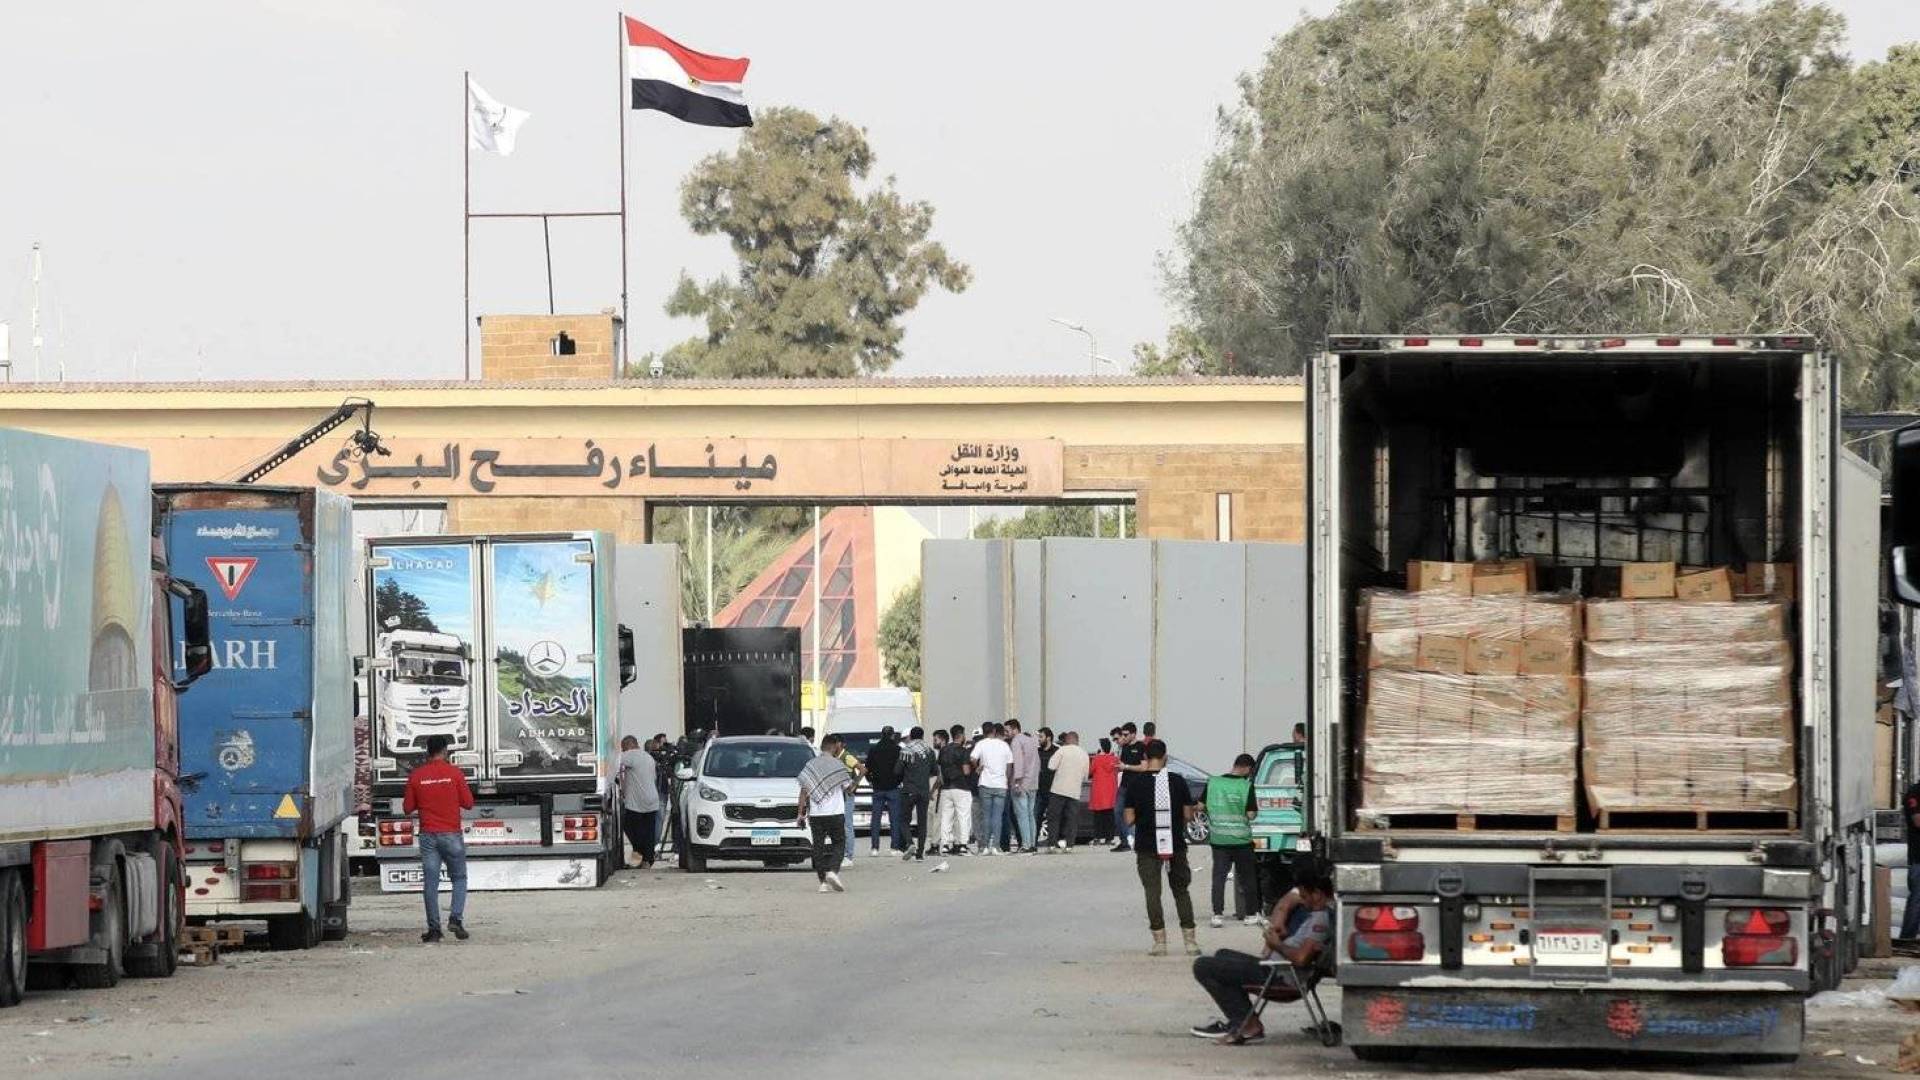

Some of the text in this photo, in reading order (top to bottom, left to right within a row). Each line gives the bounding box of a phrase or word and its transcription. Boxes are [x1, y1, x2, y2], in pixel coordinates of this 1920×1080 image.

[951, 443, 1019, 461] وزارة النقل
[471, 439, 622, 493] رفح
[629, 441, 777, 489] ميناء
[973, 464, 999, 474] العامة
[994, 480, 1027, 493] البرية
[508, 687, 588, 717] الحداد
